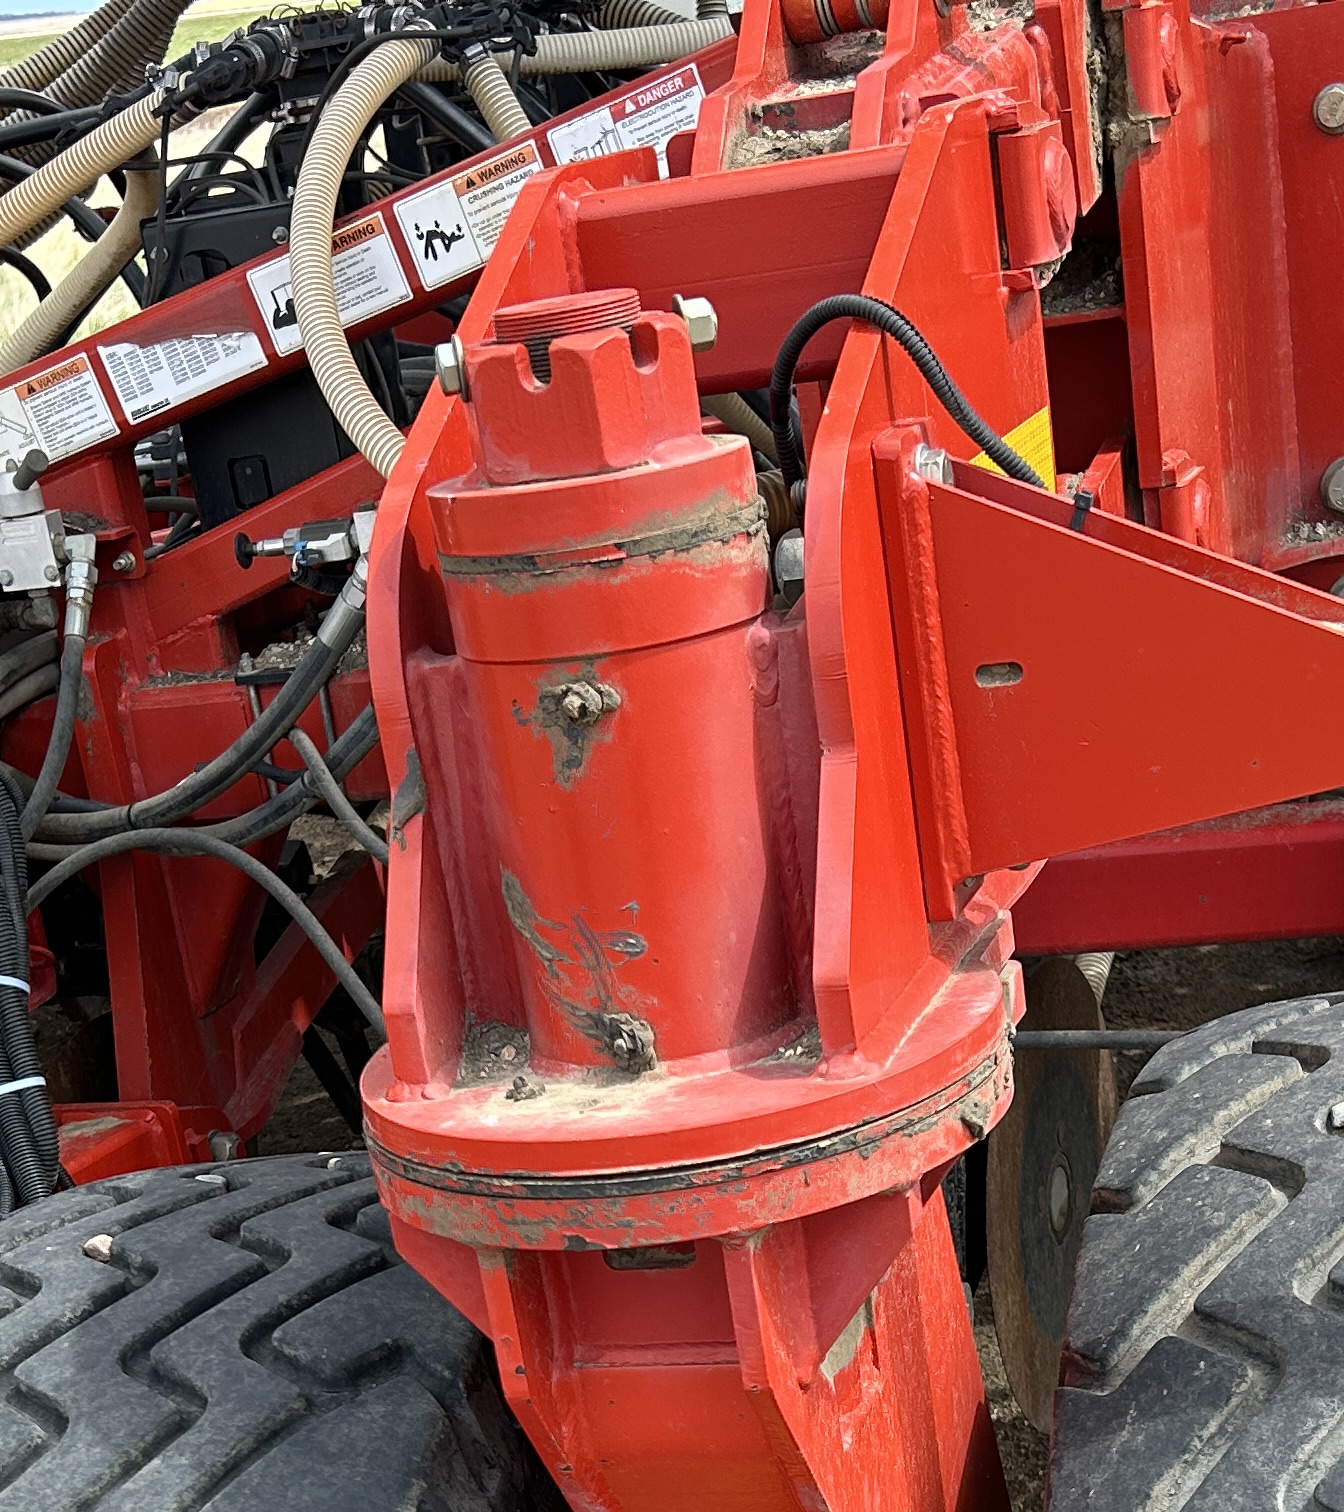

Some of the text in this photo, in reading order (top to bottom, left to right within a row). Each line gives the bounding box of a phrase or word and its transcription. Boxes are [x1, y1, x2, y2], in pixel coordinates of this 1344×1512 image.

[638, 77, 685, 106] DANGER
[621, 91, 695, 129] ELECTROCUTION HAZARD
[477, 152, 527, 183] WARNING
[467, 169, 534, 205] CRUSHING HAZARD
[332, 223, 376, 251] ARNING
[36, 363, 80, 389] WARNING
